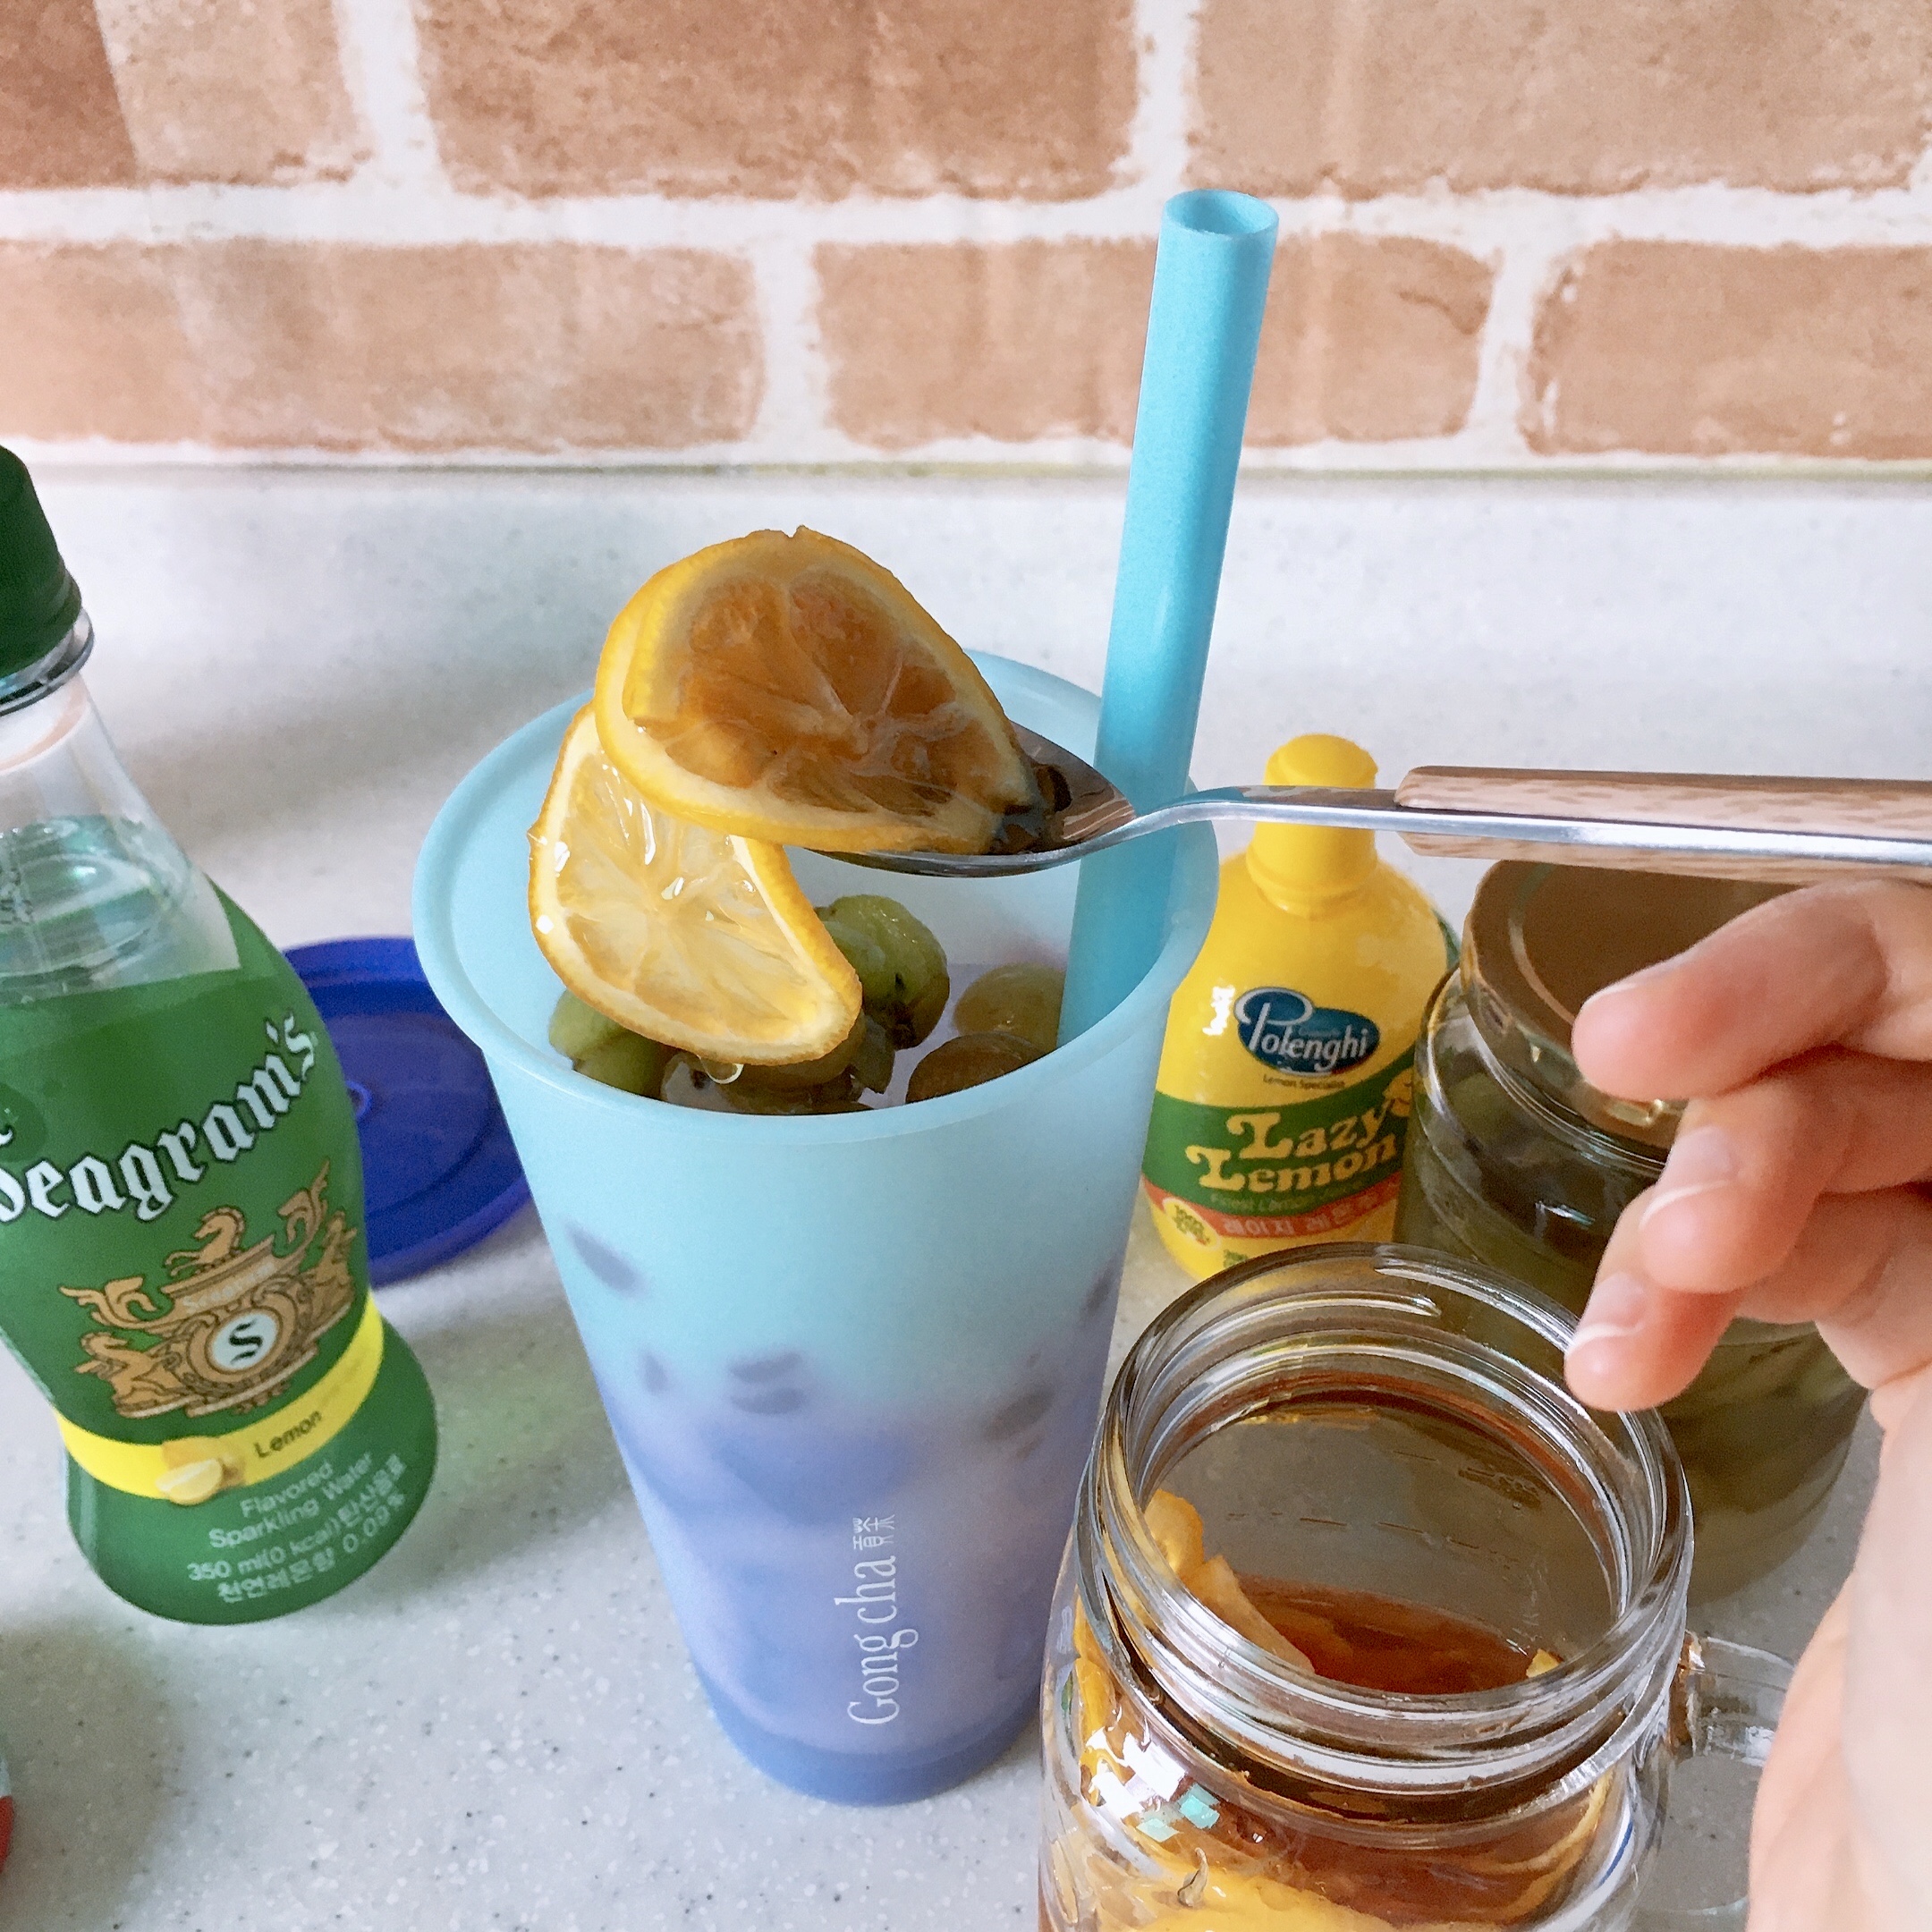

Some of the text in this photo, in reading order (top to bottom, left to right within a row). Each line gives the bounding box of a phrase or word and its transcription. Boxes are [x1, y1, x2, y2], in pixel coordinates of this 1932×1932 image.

[1235, 987, 1368, 1072] Polenghi
[1184, 1133, 1397, 1193] Lemon
[228, 1322, 263, 1362] S
[254, 1411, 323, 1459] Lemon
[208, 1452, 373, 1548] Sparkling Water
[240, 1462, 334, 1517] Flavored
[187, 1560, 233, 1581] 350
[834, 1555, 898, 1624] cha
[847, 1628, 919, 1724] Gong
